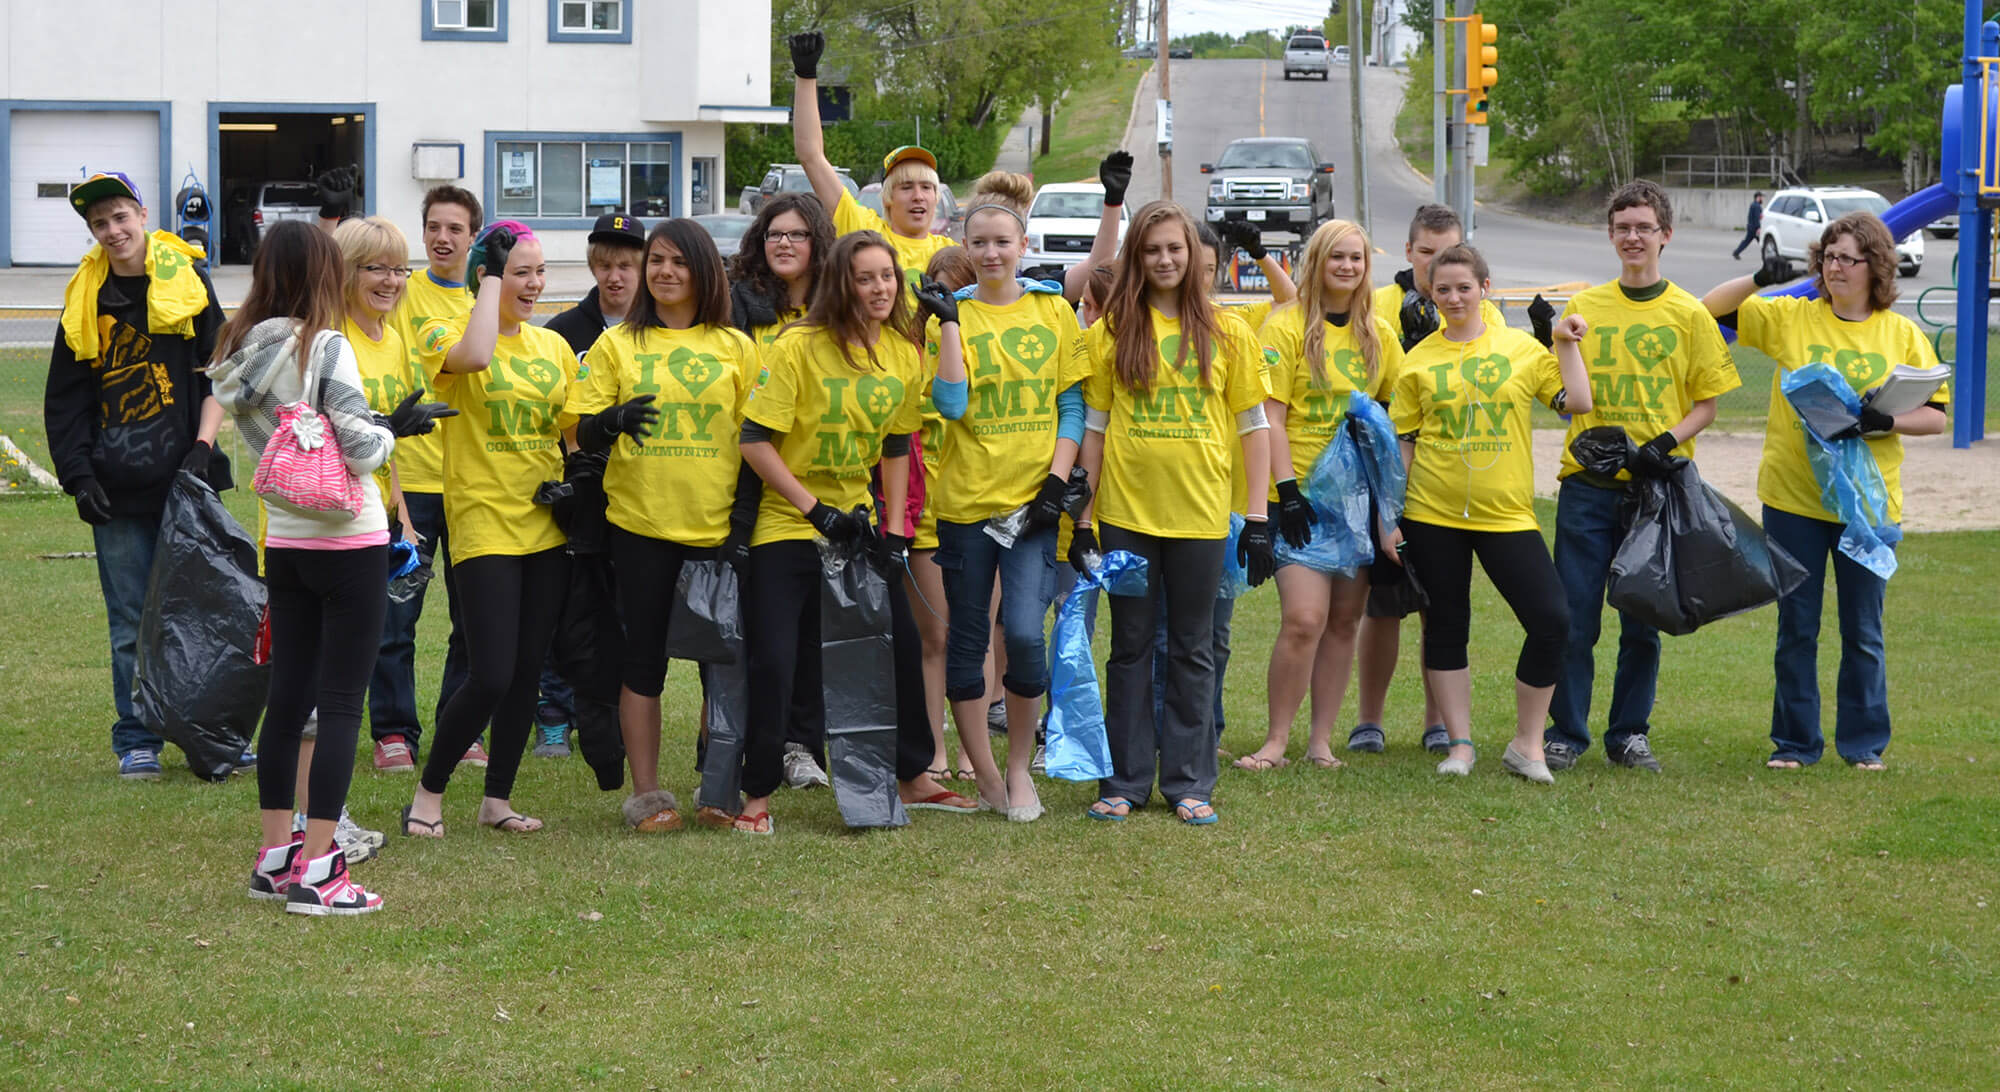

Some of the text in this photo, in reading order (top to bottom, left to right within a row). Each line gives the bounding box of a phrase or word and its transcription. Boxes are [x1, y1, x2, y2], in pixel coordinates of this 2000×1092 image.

[79, 165, 87, 179] 1
[968, 332, 1002, 378] I
[1593, 326, 1619, 366] I
[632, 353, 663, 394] I
[1428, 363, 1456, 402] I
[1591, 373, 1673, 410] MY
[820, 378, 849, 424] I
[974, 378, 1055, 419] MY
[1127, 386, 1216, 423] MY
[1303, 395, 1351, 422] M
[484, 400, 563, 436] MY
[1433, 402, 1514, 439] MY
[630, 446, 720, 458] COMMUNITY
[811, 431, 881, 467] MY
